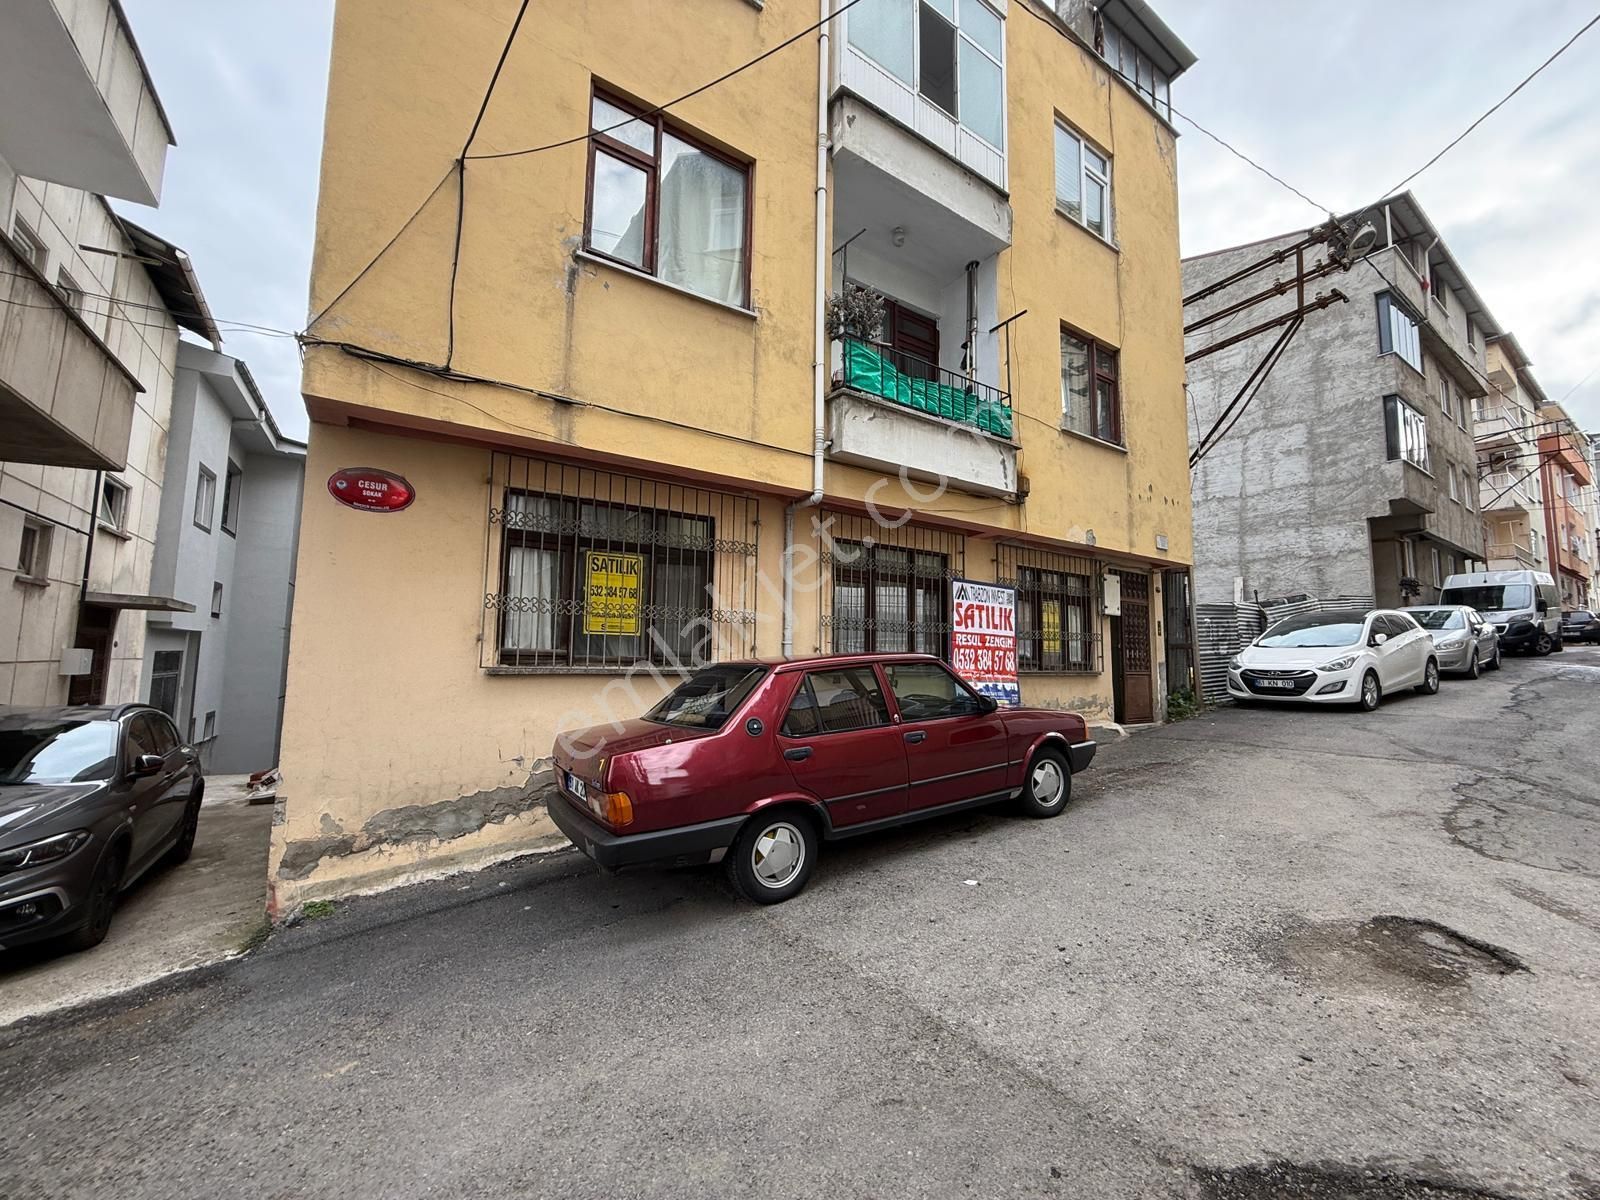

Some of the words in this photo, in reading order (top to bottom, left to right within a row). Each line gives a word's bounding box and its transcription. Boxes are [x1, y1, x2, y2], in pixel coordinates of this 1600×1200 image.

[358, 479, 388, 491] CESUR
[362, 489, 383, 498] SOKAK
[591, 556, 638, 575] SATILIK
[955, 602, 1014, 630] SATILIK
[955, 633, 982, 646] RESUL
[953, 648, 975, 670] 0532
[977, 649, 992, 671] 384
[994, 650, 1004, 671] 57
[1005, 651, 1015, 671] 68
